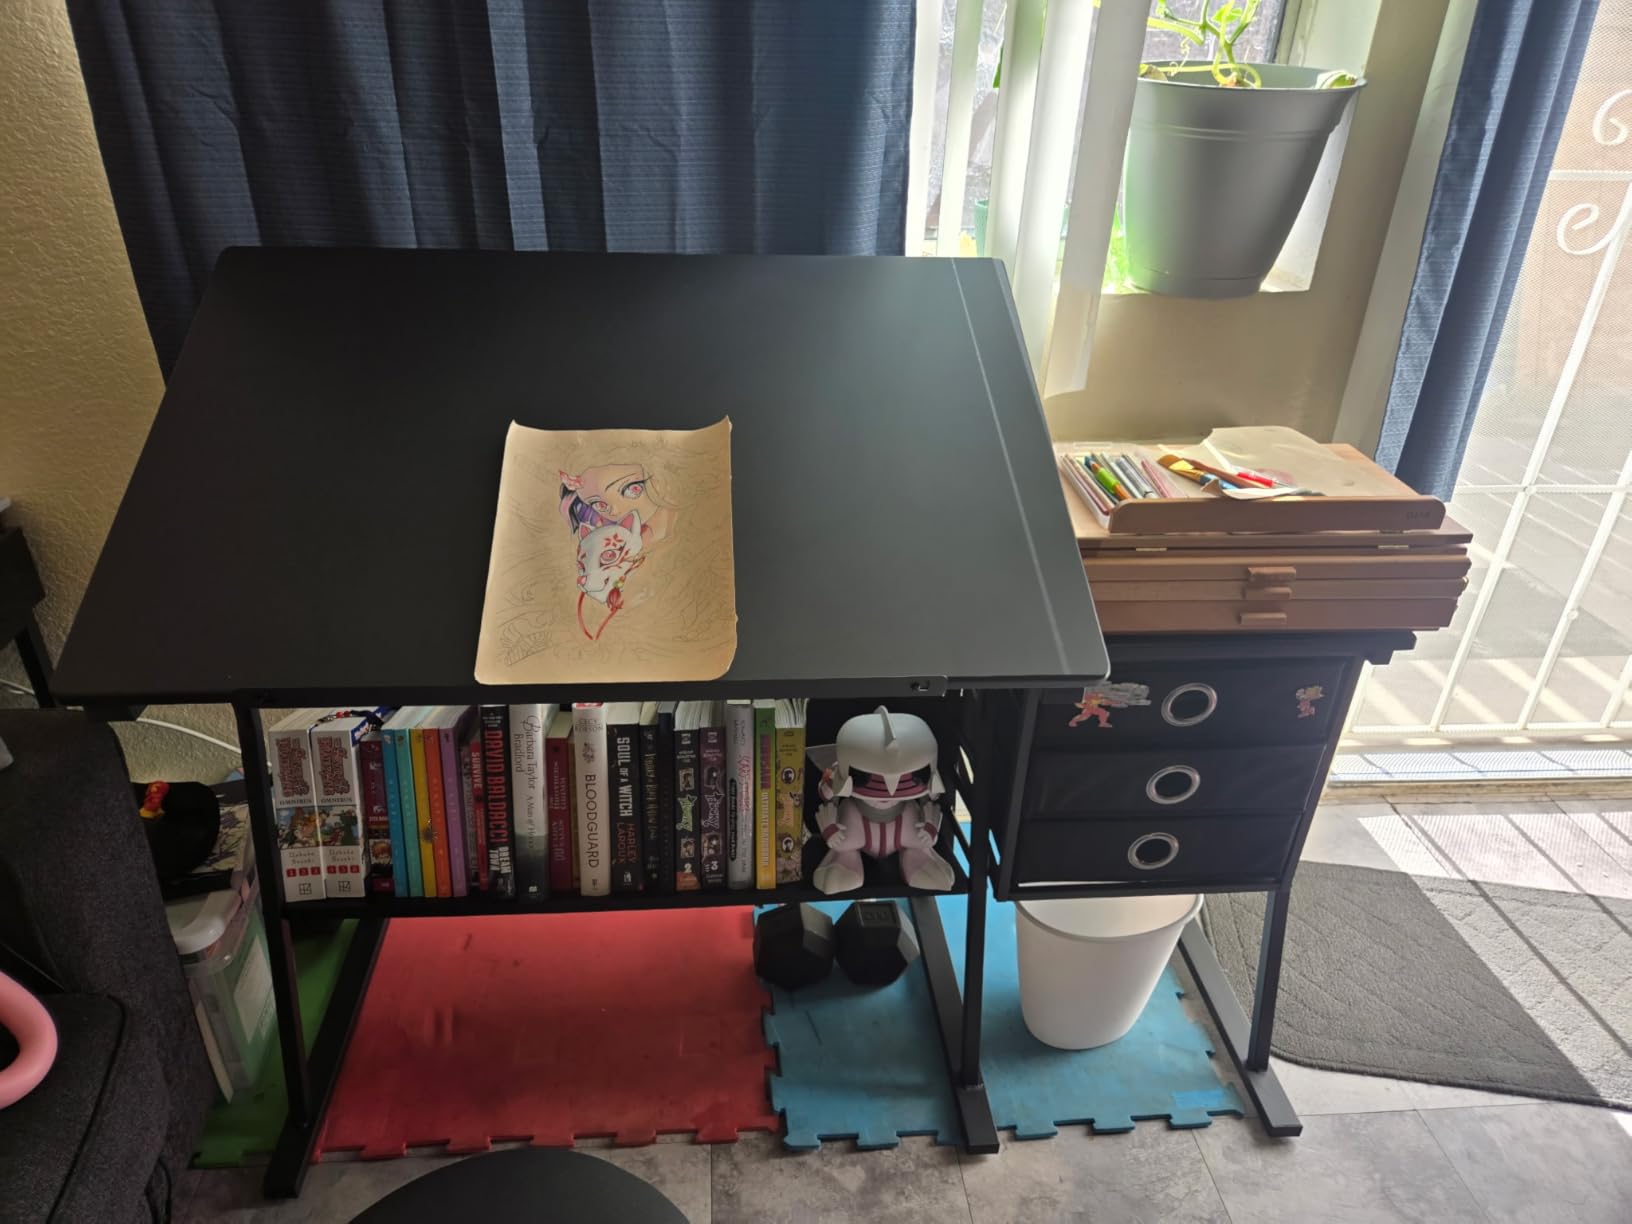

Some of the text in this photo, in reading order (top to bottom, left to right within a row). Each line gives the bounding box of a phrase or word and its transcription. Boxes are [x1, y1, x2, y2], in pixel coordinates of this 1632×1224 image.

[471, 752, 483, 789] SURVIVE
[484, 729, 505, 772] DAVID
[513, 733, 525, 773] Bradford
[521, 715, 541, 790] Barbara Taylor
[616, 737, 631, 766] SOUL
[486, 776, 509, 844] BALDACCI
[617, 783, 634, 817] WITCH
[584, 774, 601, 868] BLOODGUARD
[499, 846, 511, 874] DREAM
[616, 822, 627, 864] LAROUX
[626, 823, 636, 863] HARLEY
[683, 862, 692, 873] 2
[710, 861, 719, 871] 3
